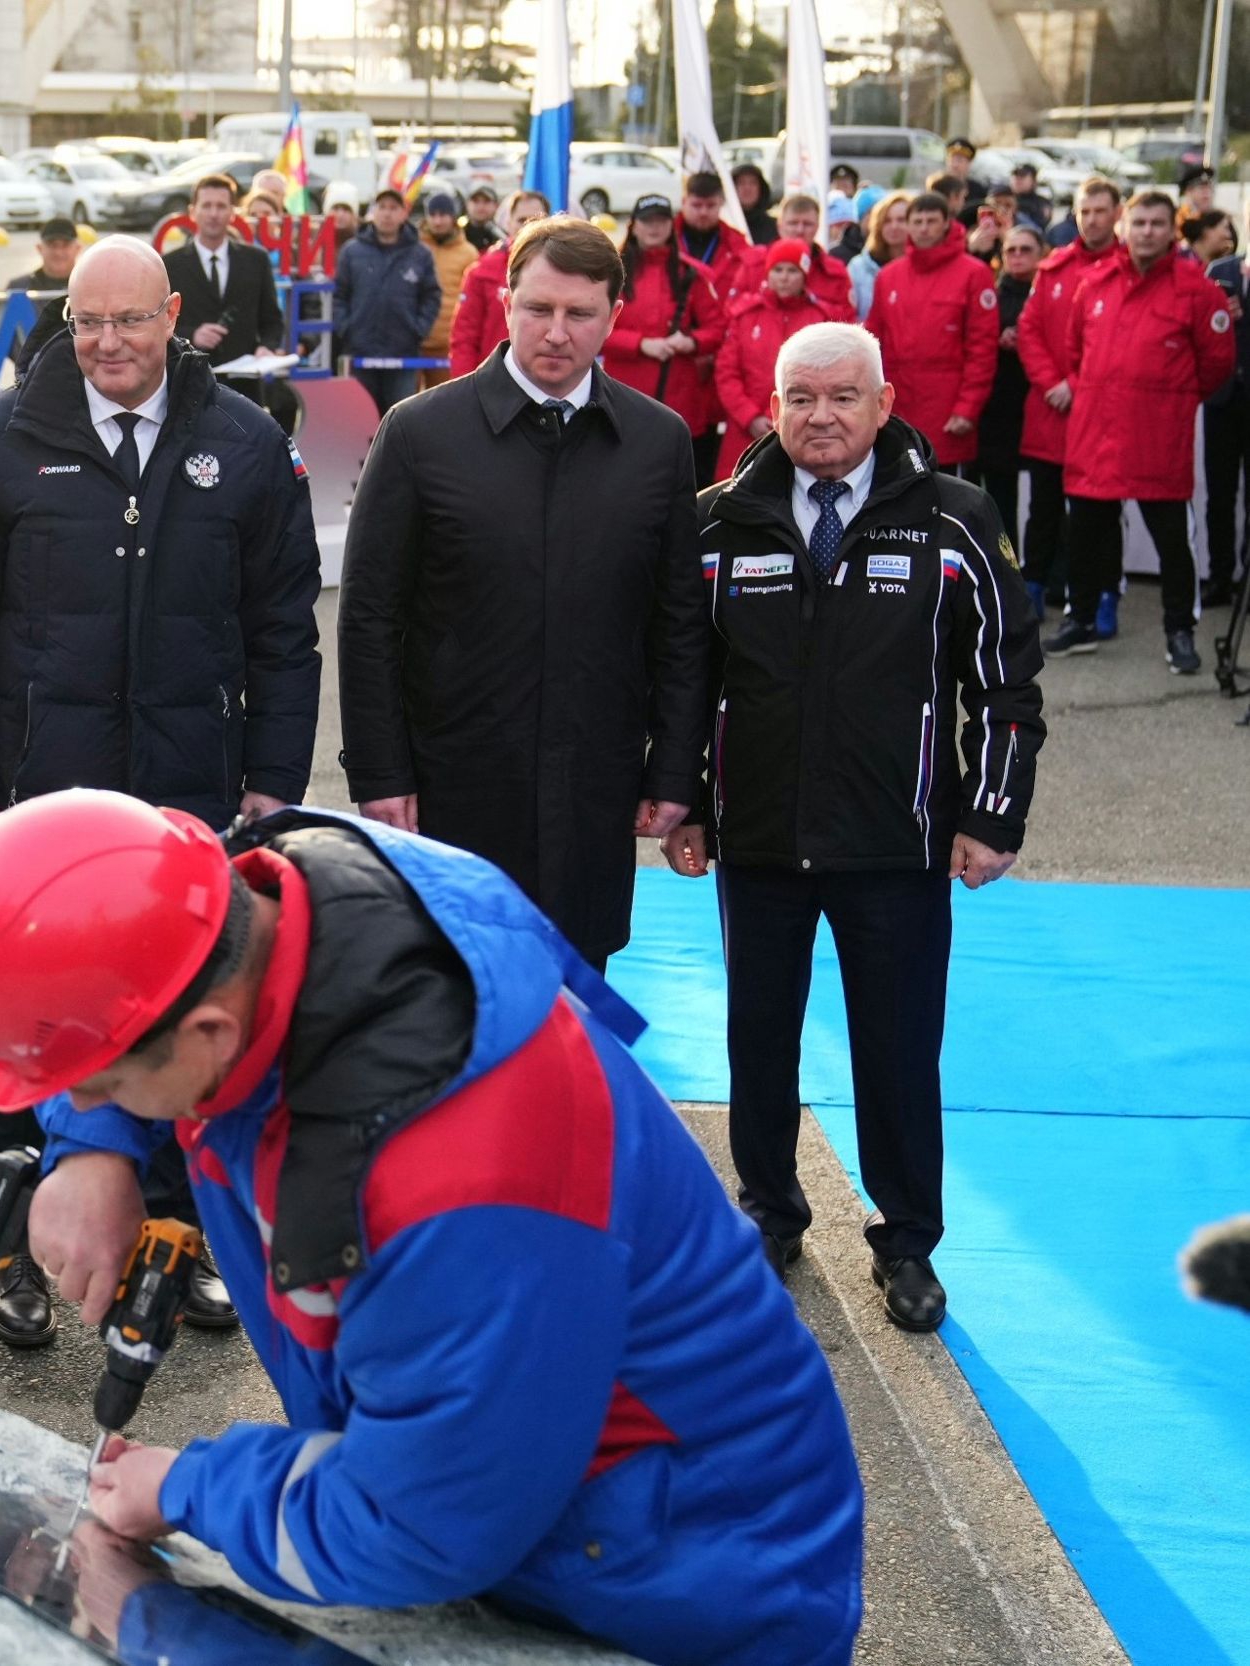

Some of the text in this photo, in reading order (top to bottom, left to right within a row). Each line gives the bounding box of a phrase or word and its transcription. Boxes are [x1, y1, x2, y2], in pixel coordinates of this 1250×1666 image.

[38, 464, 81, 475] FORWARD
[863, 528, 929, 544] UARNET
[743, 564, 790, 575] TATNEFT
[869, 559, 908, 569] SOGAZ
[741, 583, 793, 595] Rosengineering
[880, 583, 906, 595] YOTA
